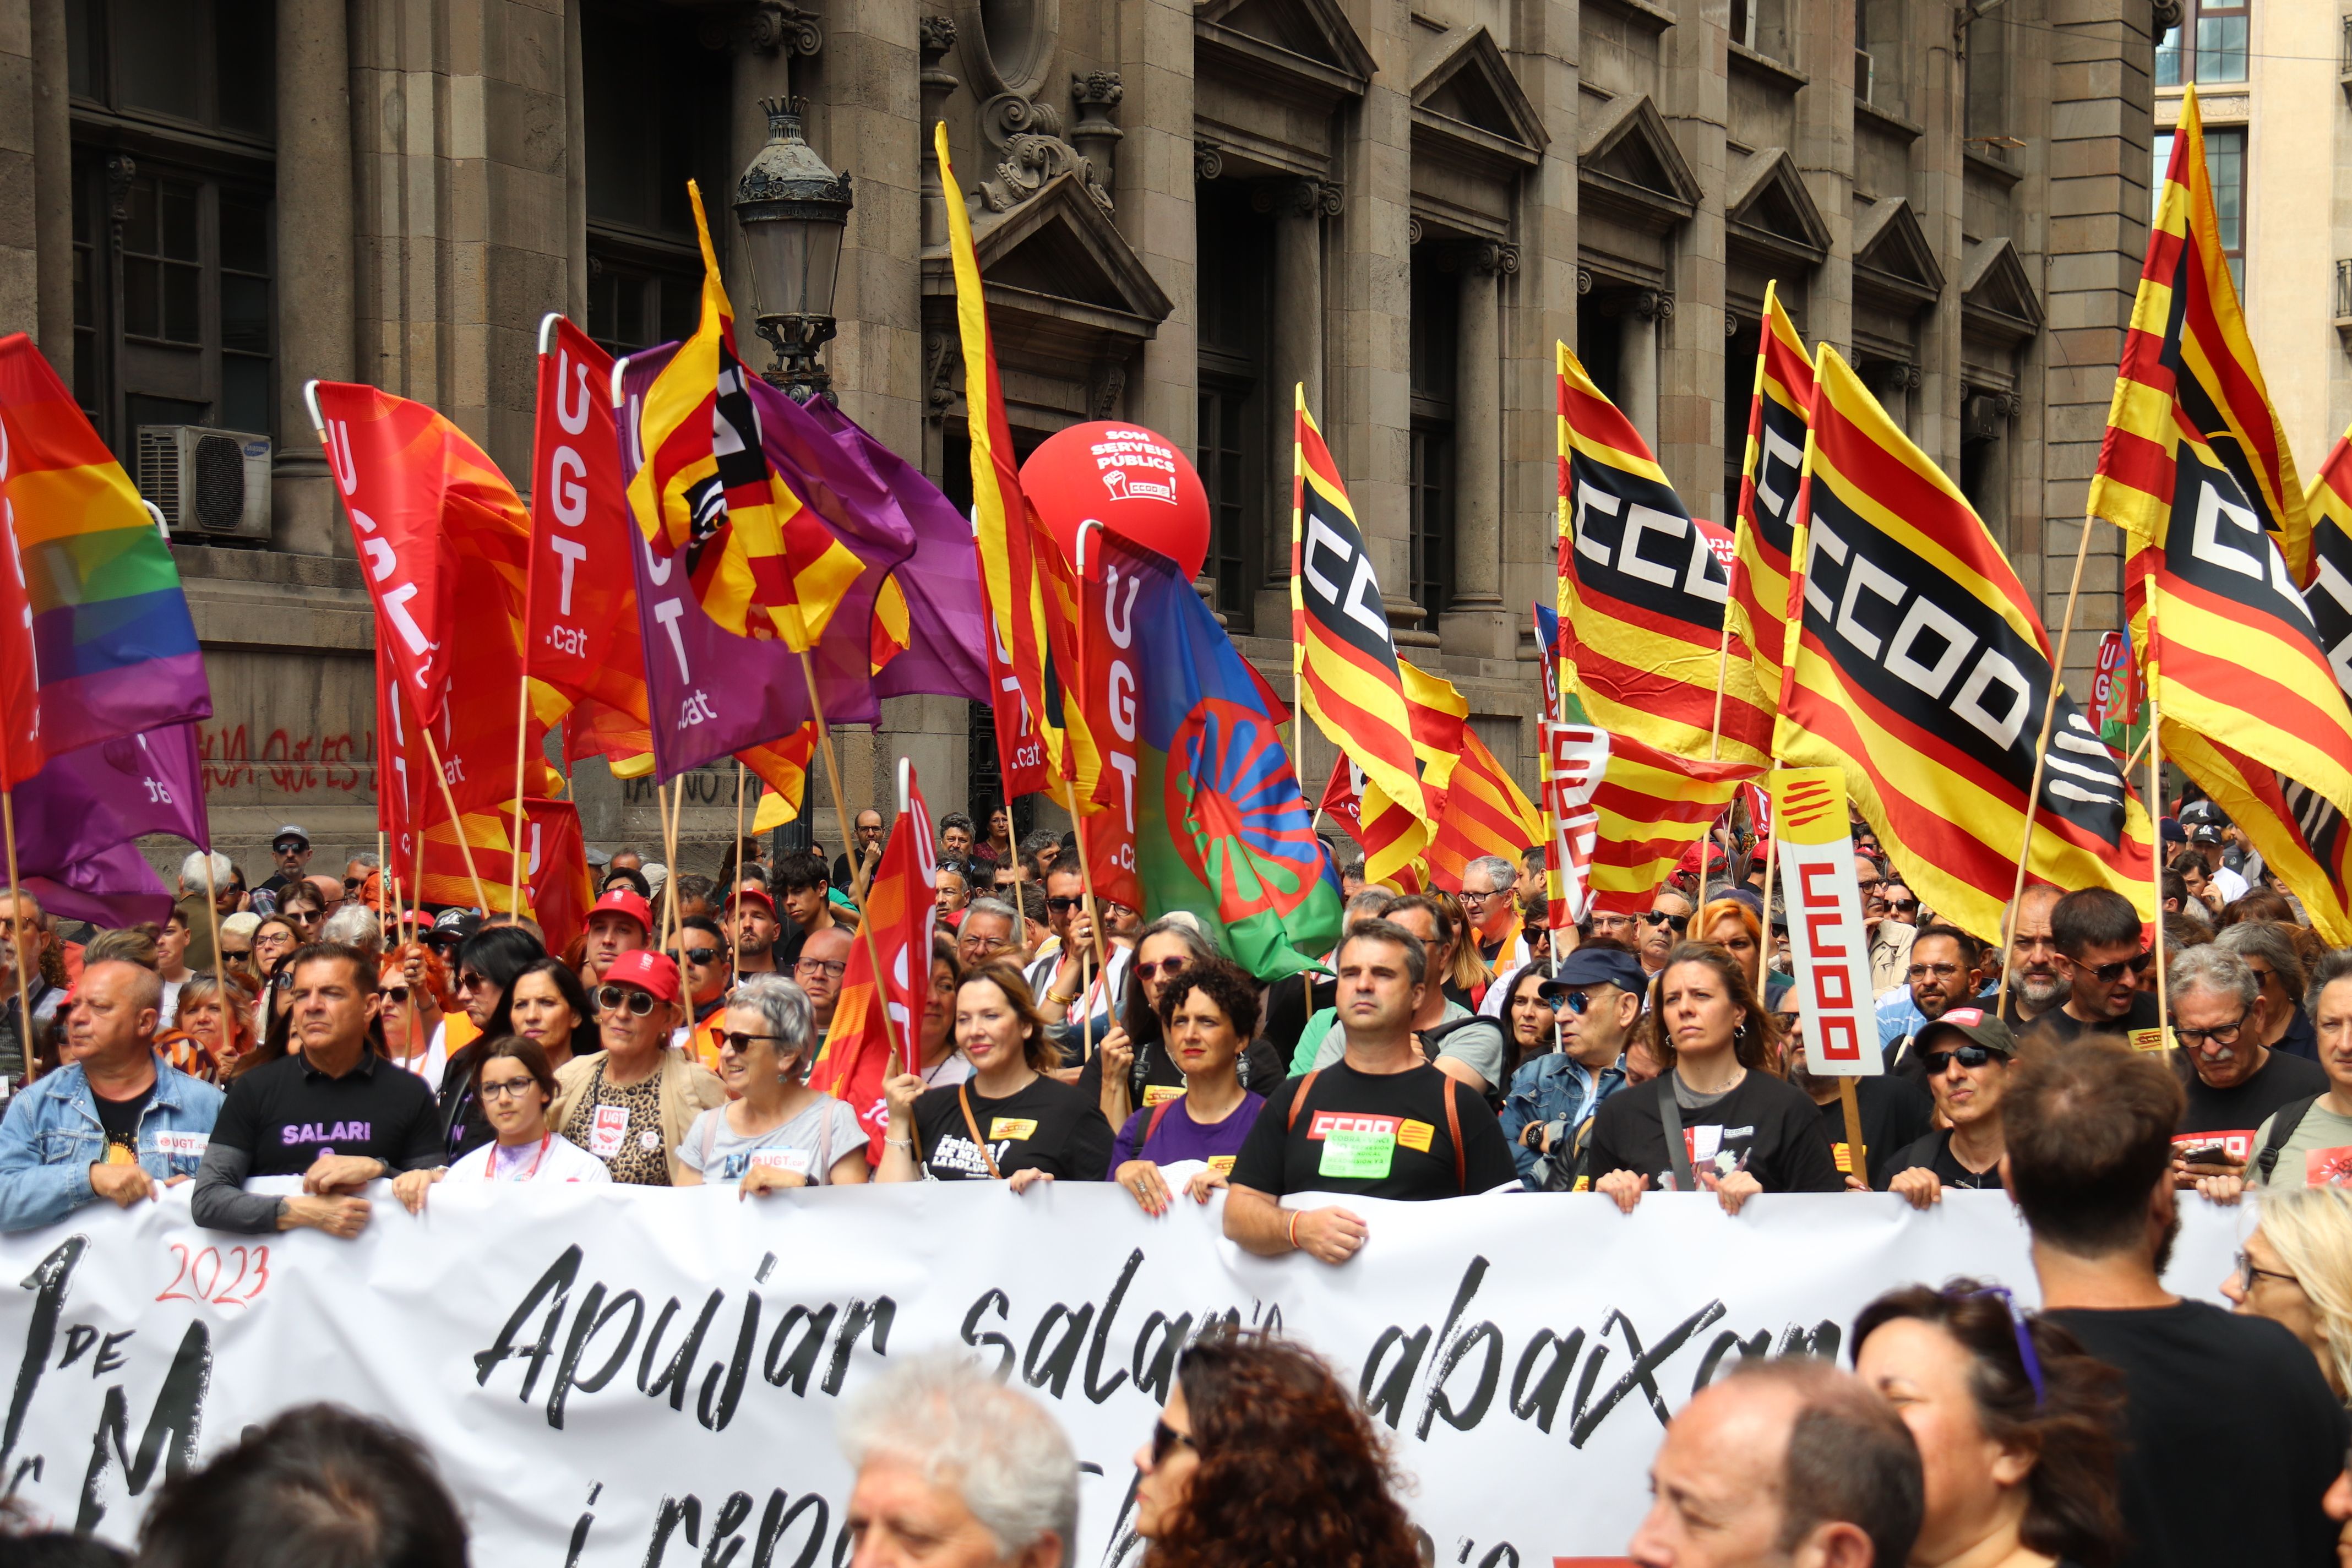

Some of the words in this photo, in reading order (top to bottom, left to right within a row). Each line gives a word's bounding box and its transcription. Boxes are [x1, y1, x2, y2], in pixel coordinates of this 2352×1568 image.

[1106, 431, 1150, 442] SOM
[1091, 442, 1173, 459] SERVEIS
[1097, 453, 1175, 473] PÚBLICS
[552, 348, 590, 616] UGT
[1805, 512, 2030, 751] CCOO
[1799, 863, 1860, 1060] CCOO
[603, 1110, 626, 1124] UGT
[1314, 1117, 1393, 1134] CCOO
[283, 1121, 371, 1144] SALARI
[935, 1146, 956, 1158] DE
[155, 1243, 270, 1309] 2023
[474, 1243, 896, 1431] Apujar
[57, 1324, 137, 1379] DE
